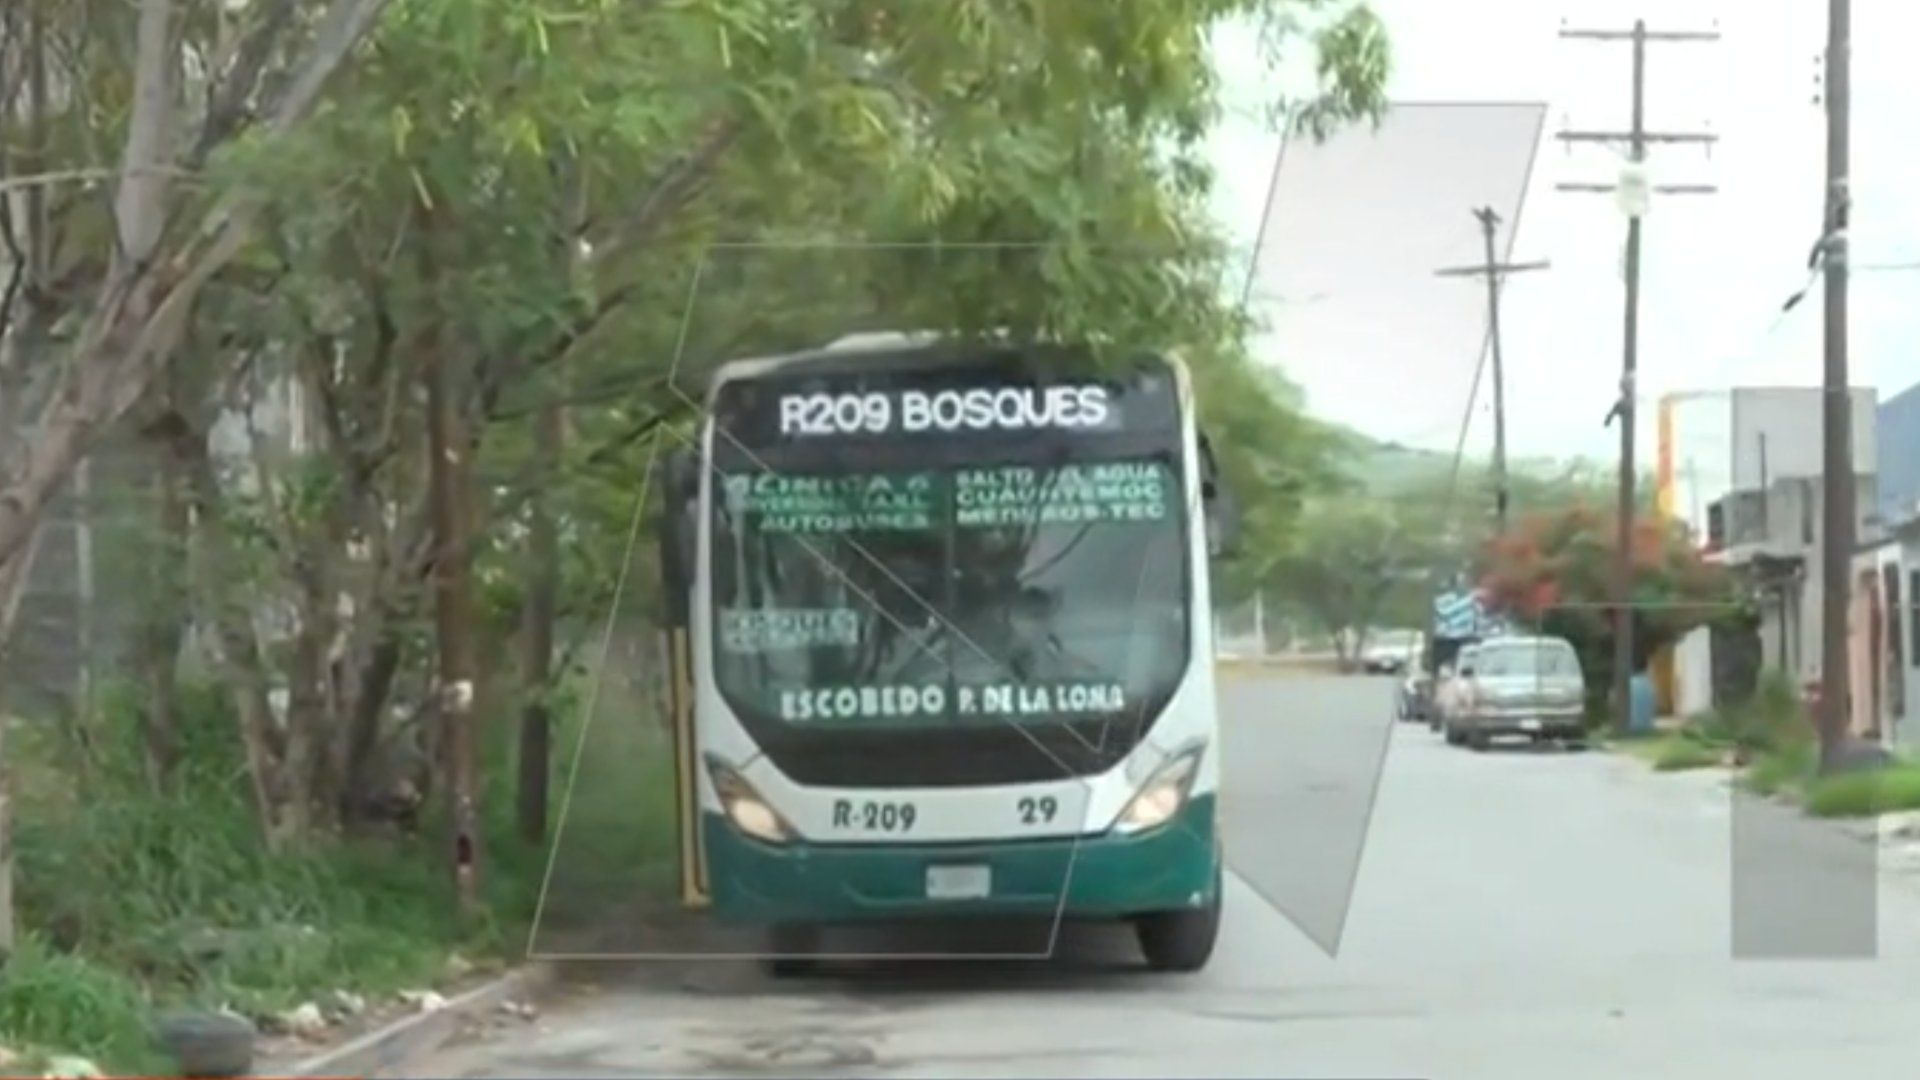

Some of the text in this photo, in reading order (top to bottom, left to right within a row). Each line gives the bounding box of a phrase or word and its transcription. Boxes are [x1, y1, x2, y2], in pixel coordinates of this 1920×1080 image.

[780, 385, 1106, 433] R209 BOSQUES
[781, 685, 944, 720] ESCOBEDO
[983, 686, 1012, 713] DE
[1019, 686, 1050, 713] LA
[833, 796, 1058, 831] R-209 29
